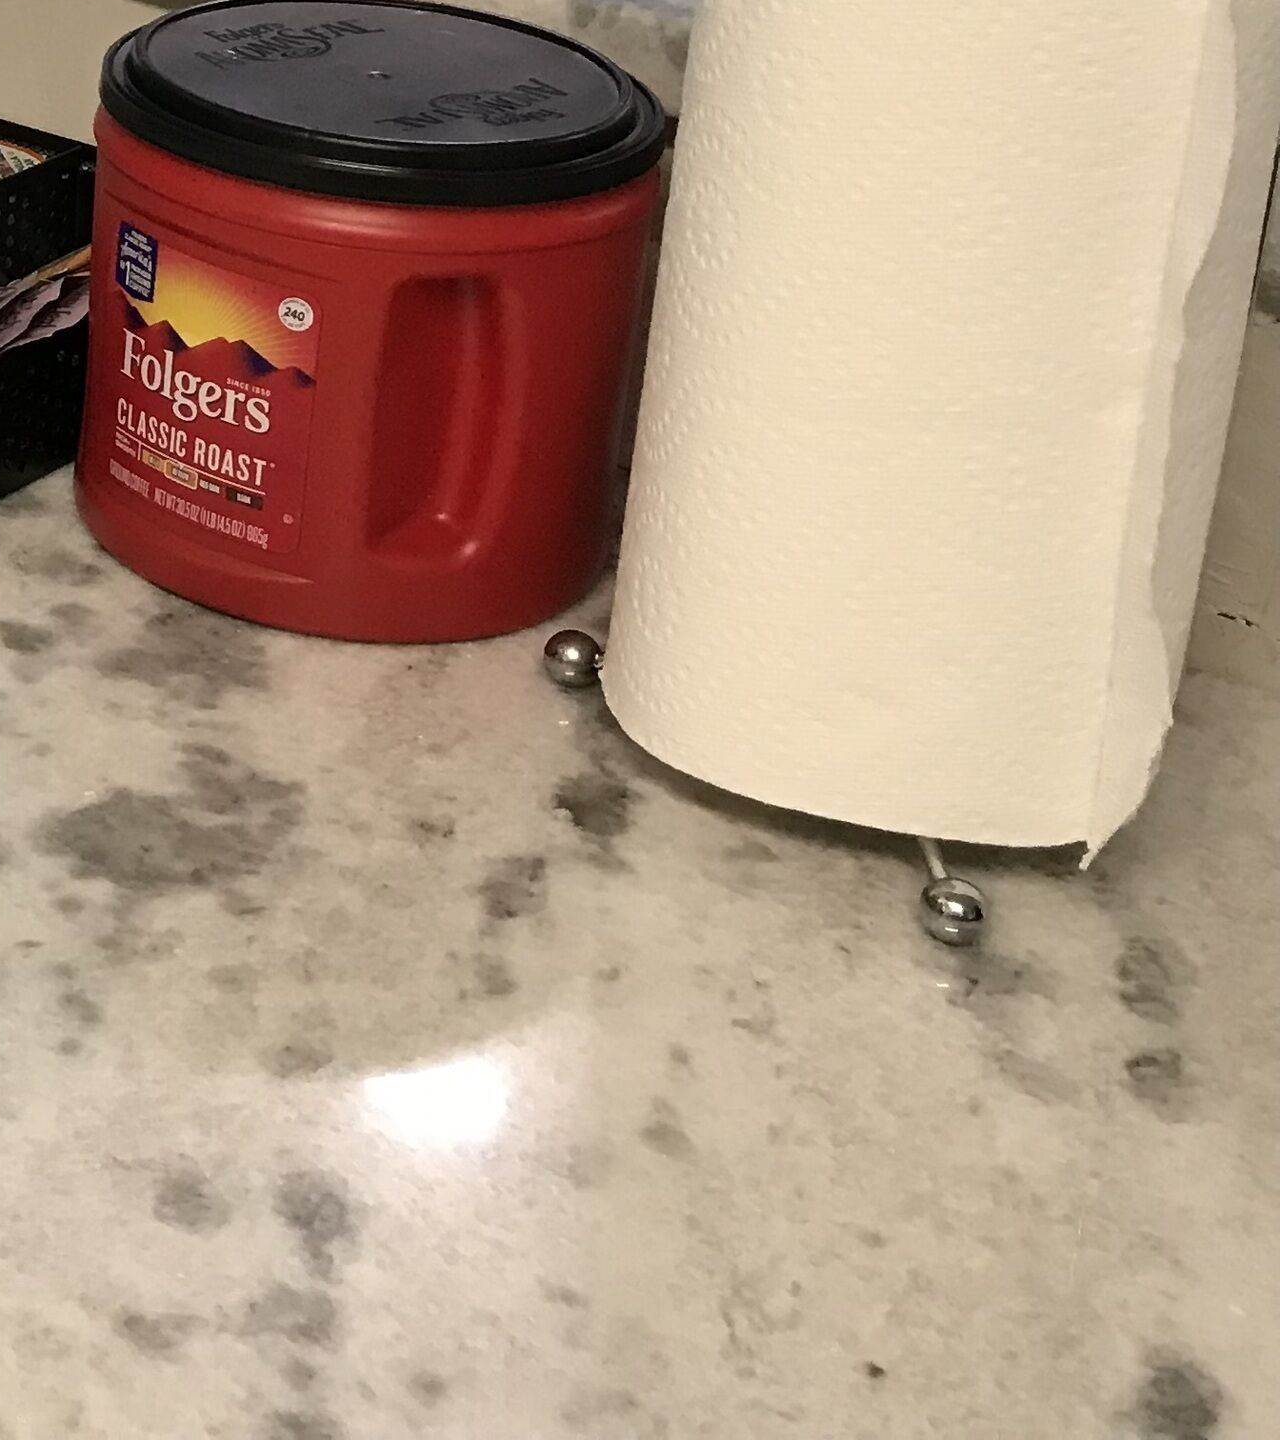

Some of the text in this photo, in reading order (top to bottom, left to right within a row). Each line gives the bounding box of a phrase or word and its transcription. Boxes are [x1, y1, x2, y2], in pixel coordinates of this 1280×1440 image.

[283, 306, 306, 322] 240
[119, 327, 271, 435] Folgers
[226, 377, 249, 391] SINCE
[116, 398, 187, 459] CLASSIC
[193, 438, 267, 487] ROAST
